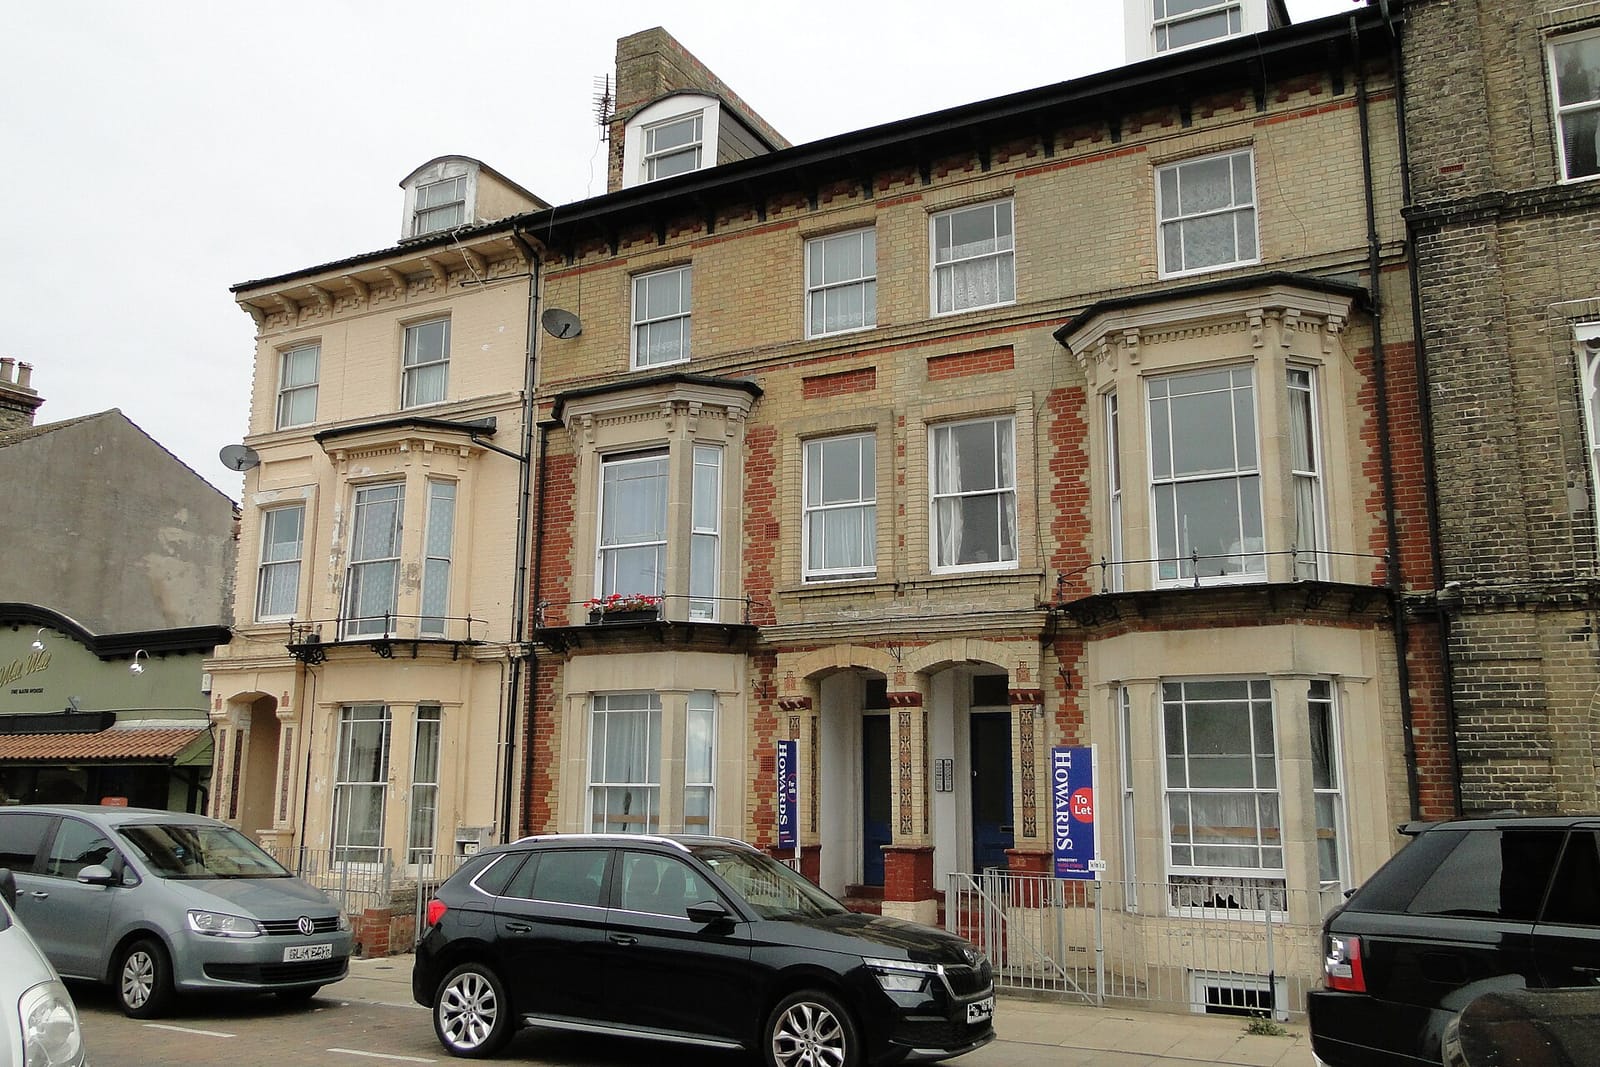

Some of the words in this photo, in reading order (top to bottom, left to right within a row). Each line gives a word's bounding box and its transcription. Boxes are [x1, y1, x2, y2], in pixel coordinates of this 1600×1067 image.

[778, 743, 788, 825] HOWARDS
[1054, 750, 1073, 850] HOWARDS
[1074, 794, 1088, 804] To
[1074, 804, 1092, 815] Let
